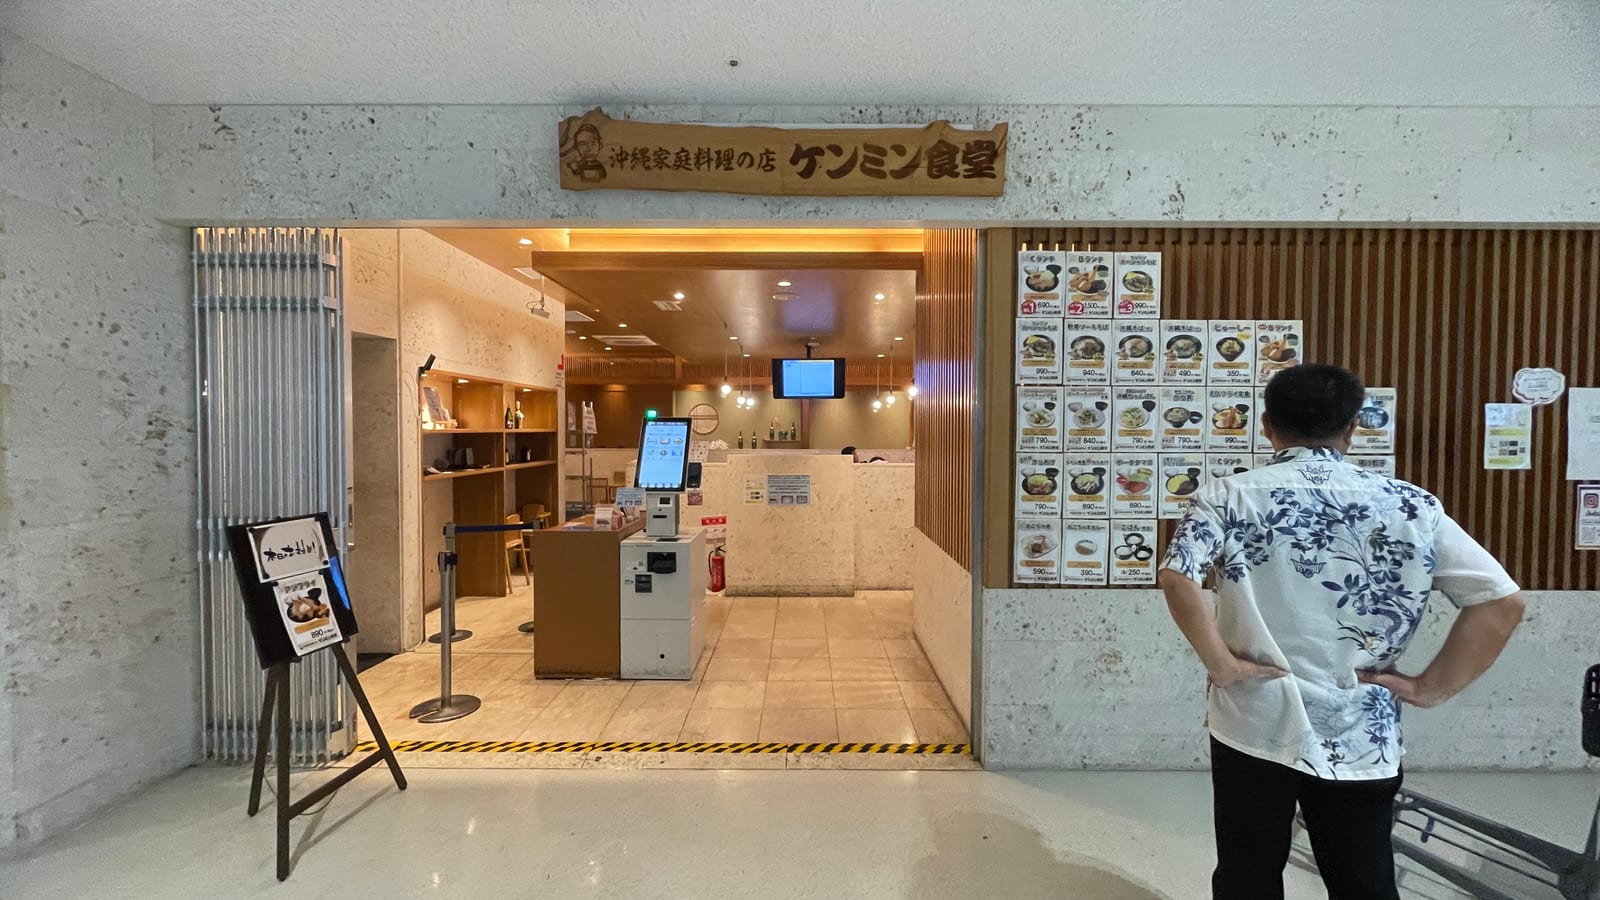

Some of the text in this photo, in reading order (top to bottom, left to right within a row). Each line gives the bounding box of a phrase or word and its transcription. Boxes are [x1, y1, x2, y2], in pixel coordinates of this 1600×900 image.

[608, 138, 998, 179] 沖縄家庭料理の店 ケンミン食堂
